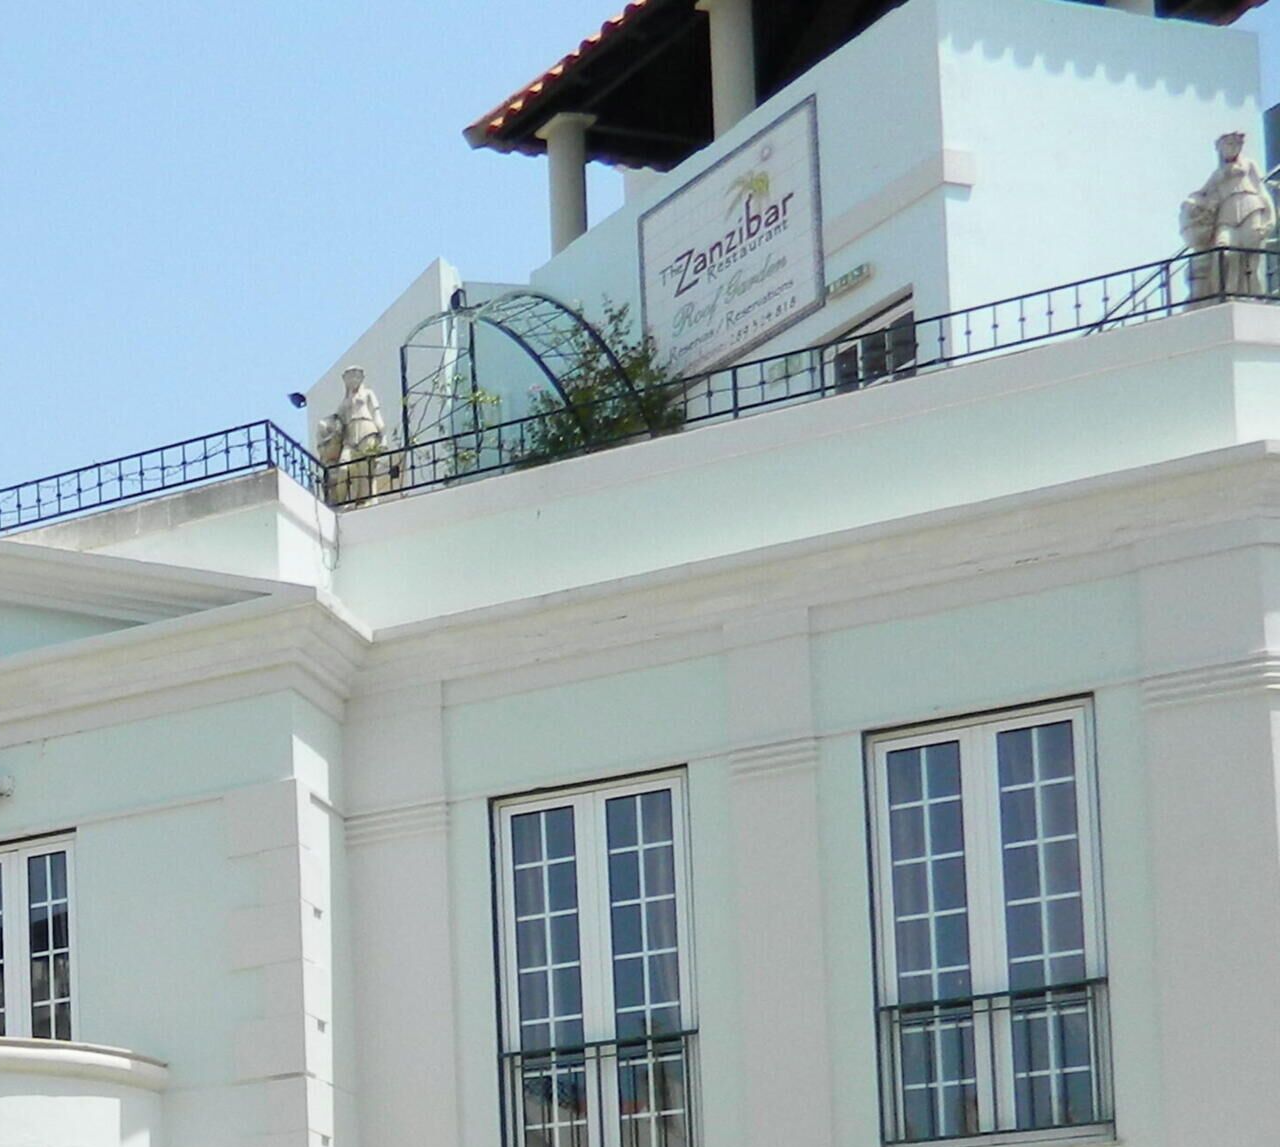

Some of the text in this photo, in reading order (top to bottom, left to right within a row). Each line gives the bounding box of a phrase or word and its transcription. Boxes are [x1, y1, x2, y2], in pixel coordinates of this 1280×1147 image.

[674, 192, 794, 297] Zanzibar
[707, 220, 788, 283] Restaurant
[672, 285, 722, 338] Roof
[724, 253, 786, 305] Garden
[726, 280, 794, 329] Reservations
